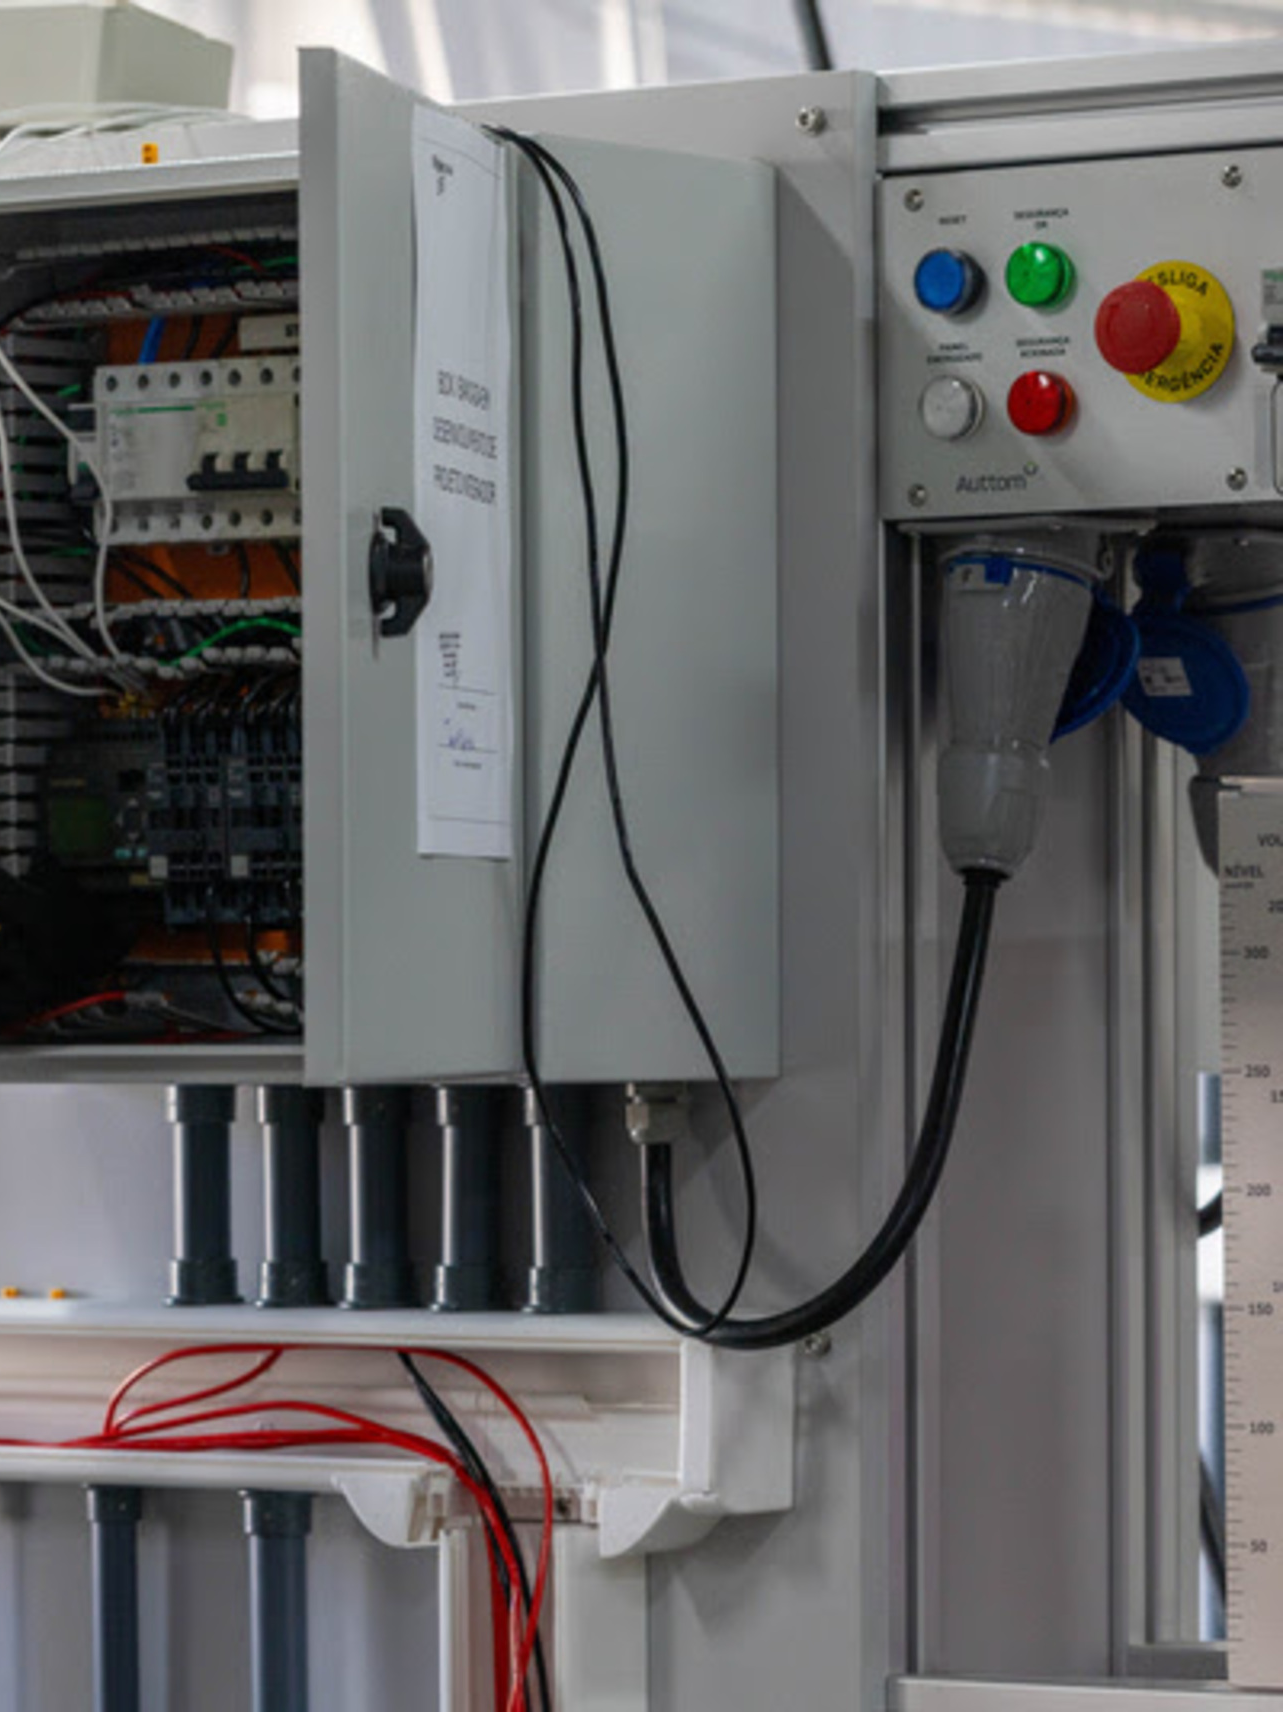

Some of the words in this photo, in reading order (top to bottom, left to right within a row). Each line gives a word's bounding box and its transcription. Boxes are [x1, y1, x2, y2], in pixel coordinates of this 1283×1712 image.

[1244, 1064, 1270, 1078] 250
[1247, 1183, 1271, 1197] 200
[1248, 1302, 1273, 1316] 150
[1250, 1421, 1274, 1435] 100
[1250, 1540, 1268, 1553] 50
